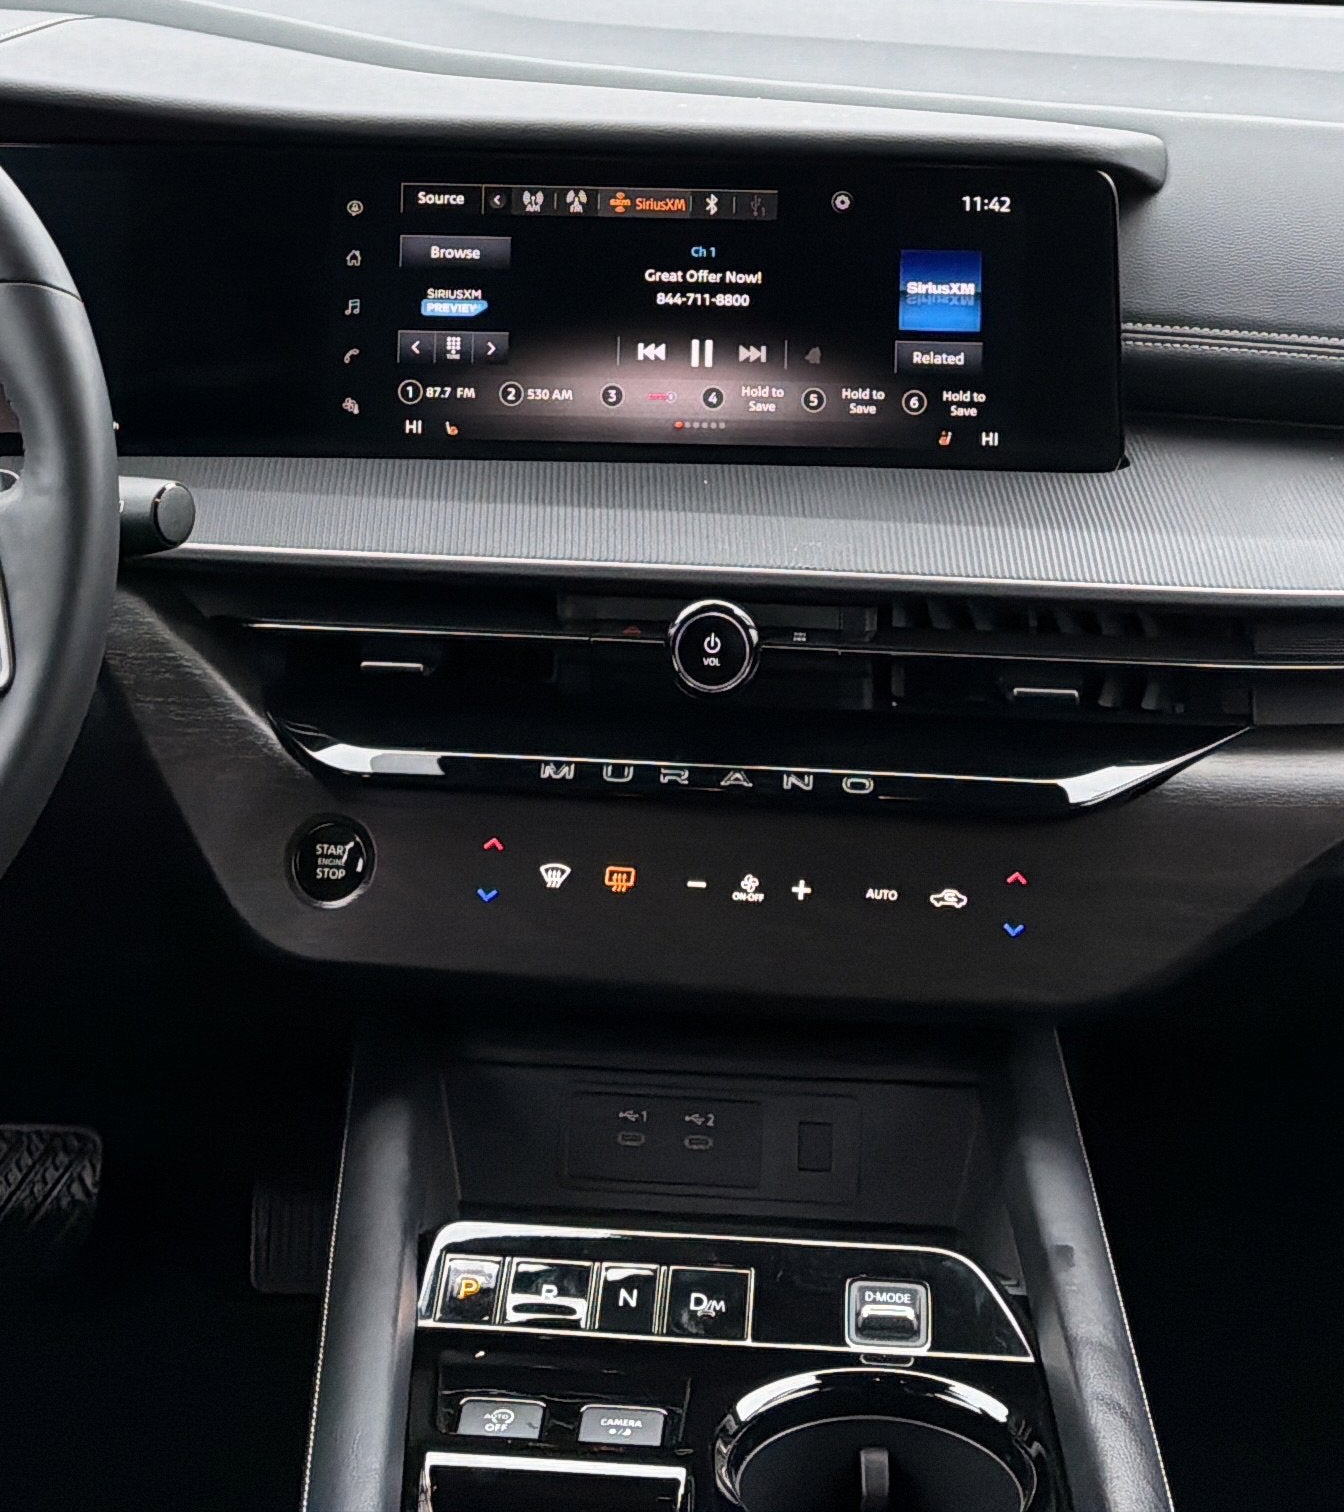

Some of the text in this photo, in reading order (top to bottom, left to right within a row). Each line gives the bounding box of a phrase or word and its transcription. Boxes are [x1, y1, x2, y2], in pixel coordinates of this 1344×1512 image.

[417, 191, 465, 205] Source
[635, 197, 686, 211] SiriusXM
[961, 195, 1012, 213] 11:42
[430, 245, 481, 260] Browse
[690, 246, 716, 258] Ch 1
[644, 268, 762, 284] Great Offer Now!
[426, 288, 482, 299] SIRIUSXM
[906, 281, 976, 296] SiriusXM
[656, 292, 750, 307] 844-711-8800
[912, 351, 965, 366] Related
[406, 386, 476, 399] 1 87.7 FM
[506, 388, 573, 401] 2 530 AM
[607, 389, 617, 402] 3
[707, 385, 785, 405] 4 Hold to
[809, 388, 886, 406] 5 Hold to
[909, 390, 987, 408] 6 Hold to
[748, 400, 777, 412] Save
[849, 402, 877, 415] Save
[950, 405, 978, 417] Save
[405, 419, 422, 434] HI
[981, 431, 999, 447] HI
[702, 657, 721, 667] VOL
[540, 762, 874, 795] MURANO
[316, 867, 346, 880] STOP
[865, 888, 899, 901] AUTO
[458, 1279, 481, 1300] P
[618, 1288, 638, 1308] N
[864, 1290, 912, 1304] D-MODE
[484, 1422, 508, 1432] OFF
[600, 1418, 643, 1428] CAMERA
